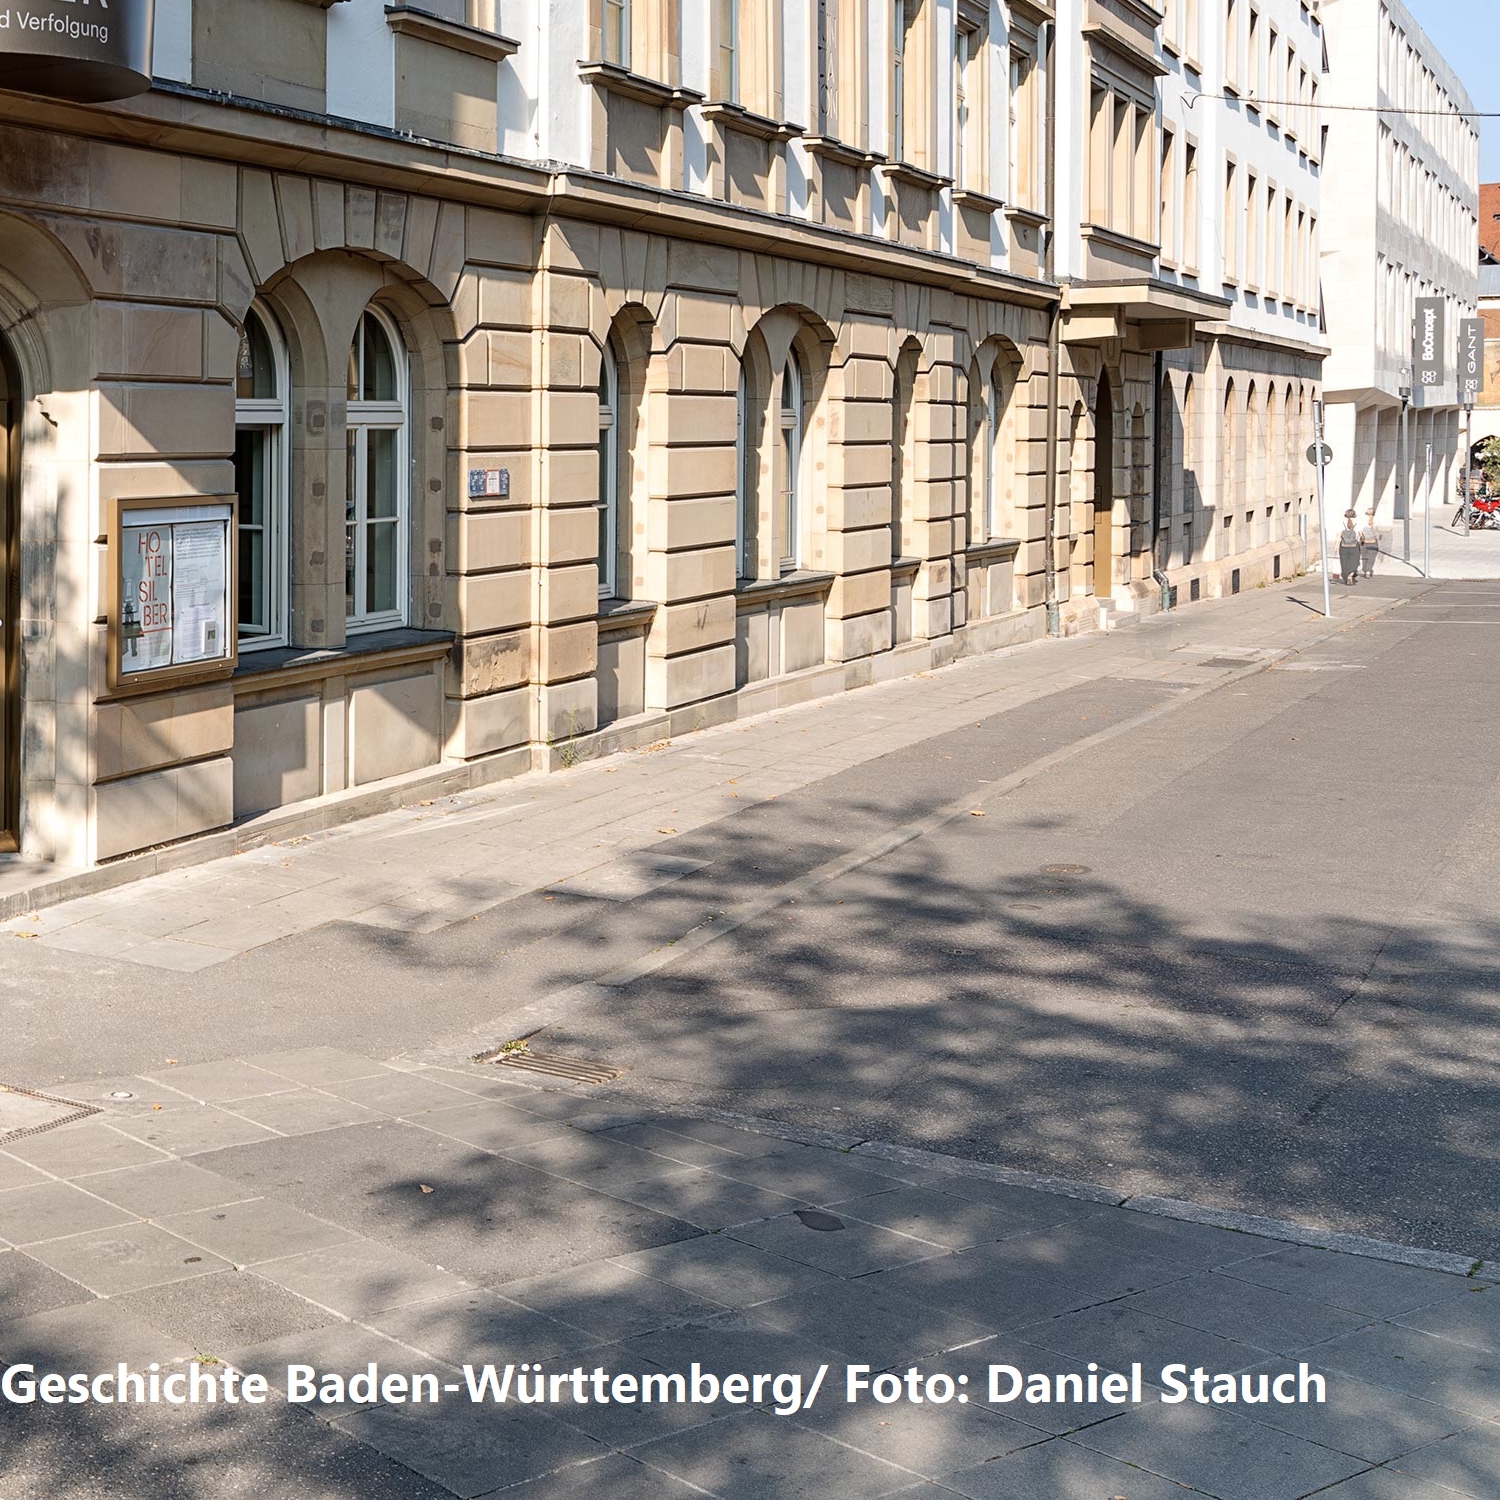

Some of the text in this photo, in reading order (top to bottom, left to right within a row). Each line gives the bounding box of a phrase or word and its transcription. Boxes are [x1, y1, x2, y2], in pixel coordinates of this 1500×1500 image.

[16, 11, 108, 43] Verfolgung
[1421, 308, 1437, 361] BoConcept
[1467, 324, 1477, 374] GANT
[138, 531, 161, 554] HO
[145, 555, 168, 577] TEL
[138, 580, 157, 603] SIL
[143, 603, 168, 627] BER
